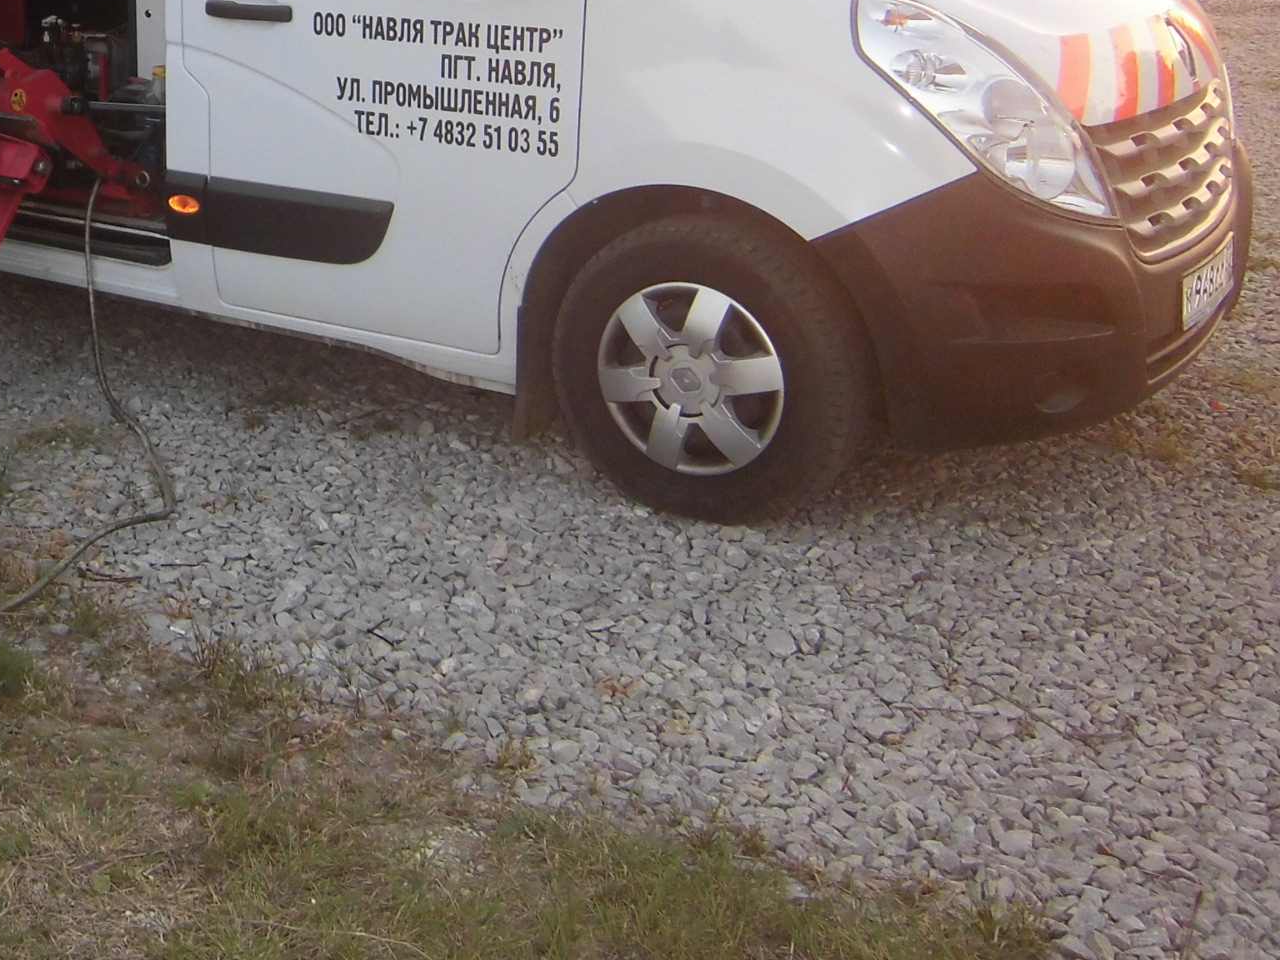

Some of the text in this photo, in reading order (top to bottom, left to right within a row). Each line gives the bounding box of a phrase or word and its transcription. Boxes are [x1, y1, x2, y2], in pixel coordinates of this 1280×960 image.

[313, 11, 346, 37] ООО
[430, 19, 480, 48] ТРАК
[440, 54, 561, 94] ПГТ. НАВЛЯ,
[336, 76, 561, 125] УЛ. ПРОМЫШЛЕННАЯ, 6
[354, 109, 559, 158] ТЕЛ.: +7 4832 51 03 55
